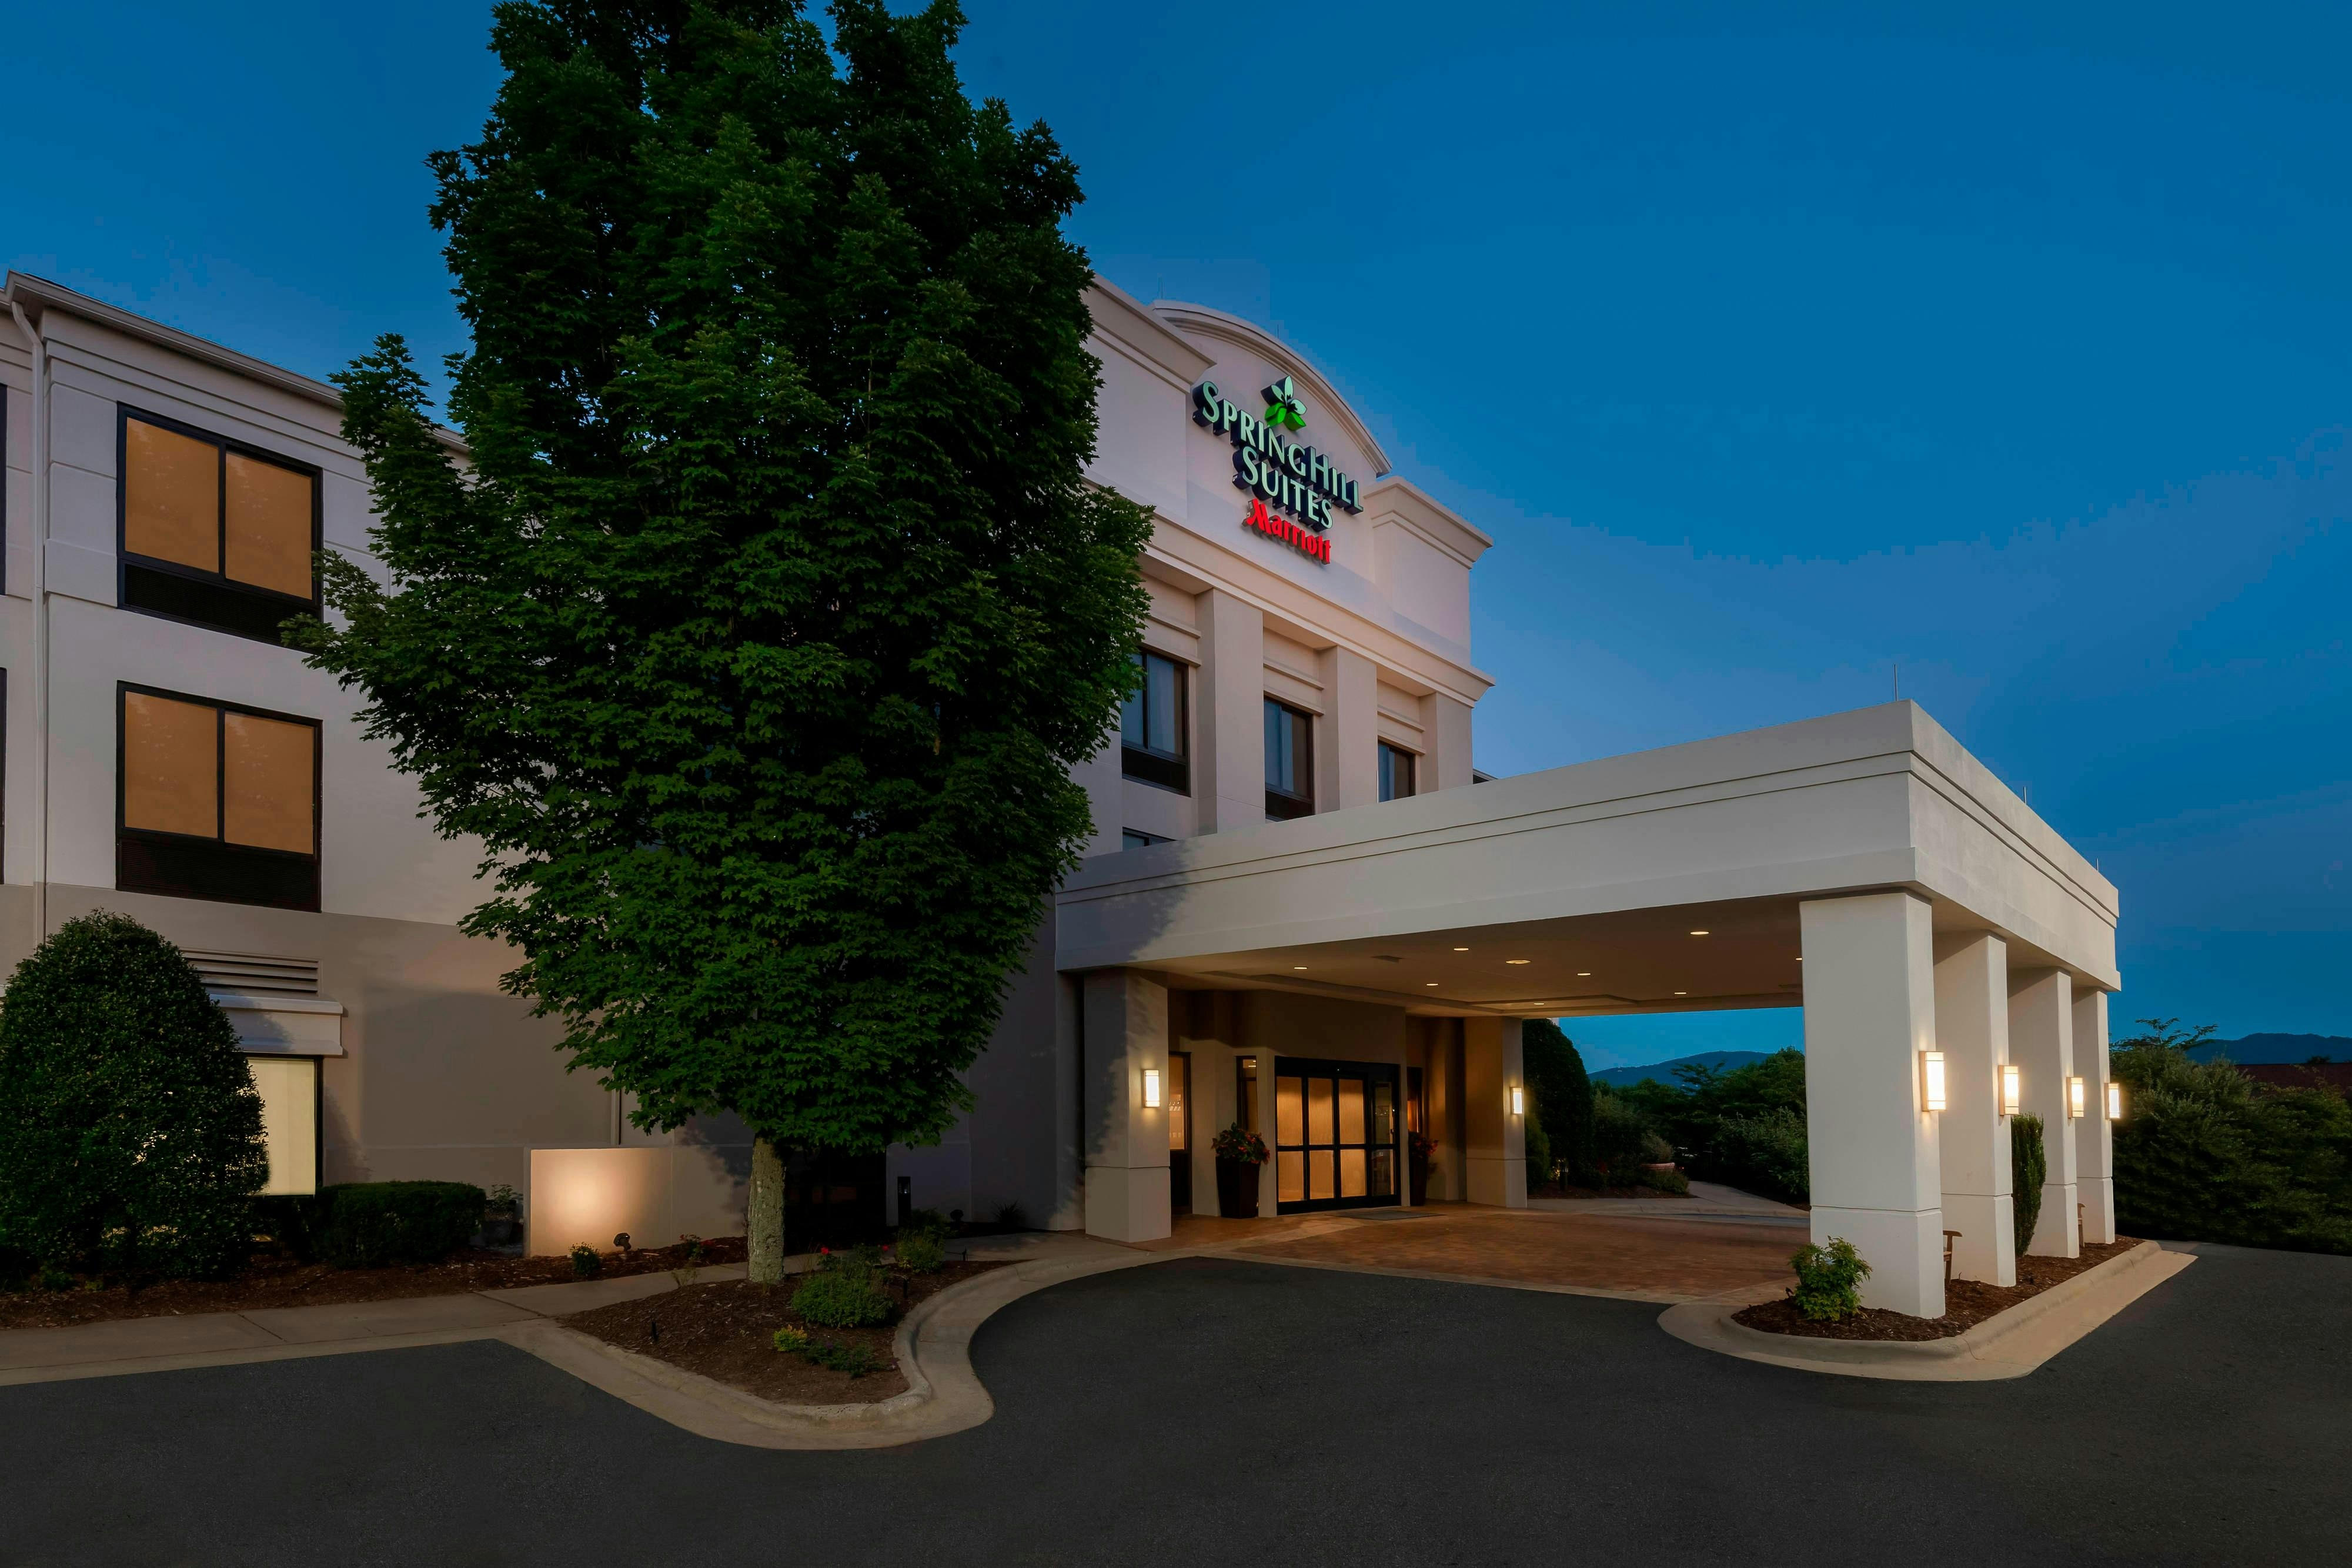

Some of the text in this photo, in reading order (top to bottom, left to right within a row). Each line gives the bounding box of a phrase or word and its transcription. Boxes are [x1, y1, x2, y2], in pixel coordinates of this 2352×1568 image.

[1198, 381, 1364, 513] SPRINGHILL
[1238, 446, 1333, 530] SUITES
[1245, 498, 1331, 564] Marriott
